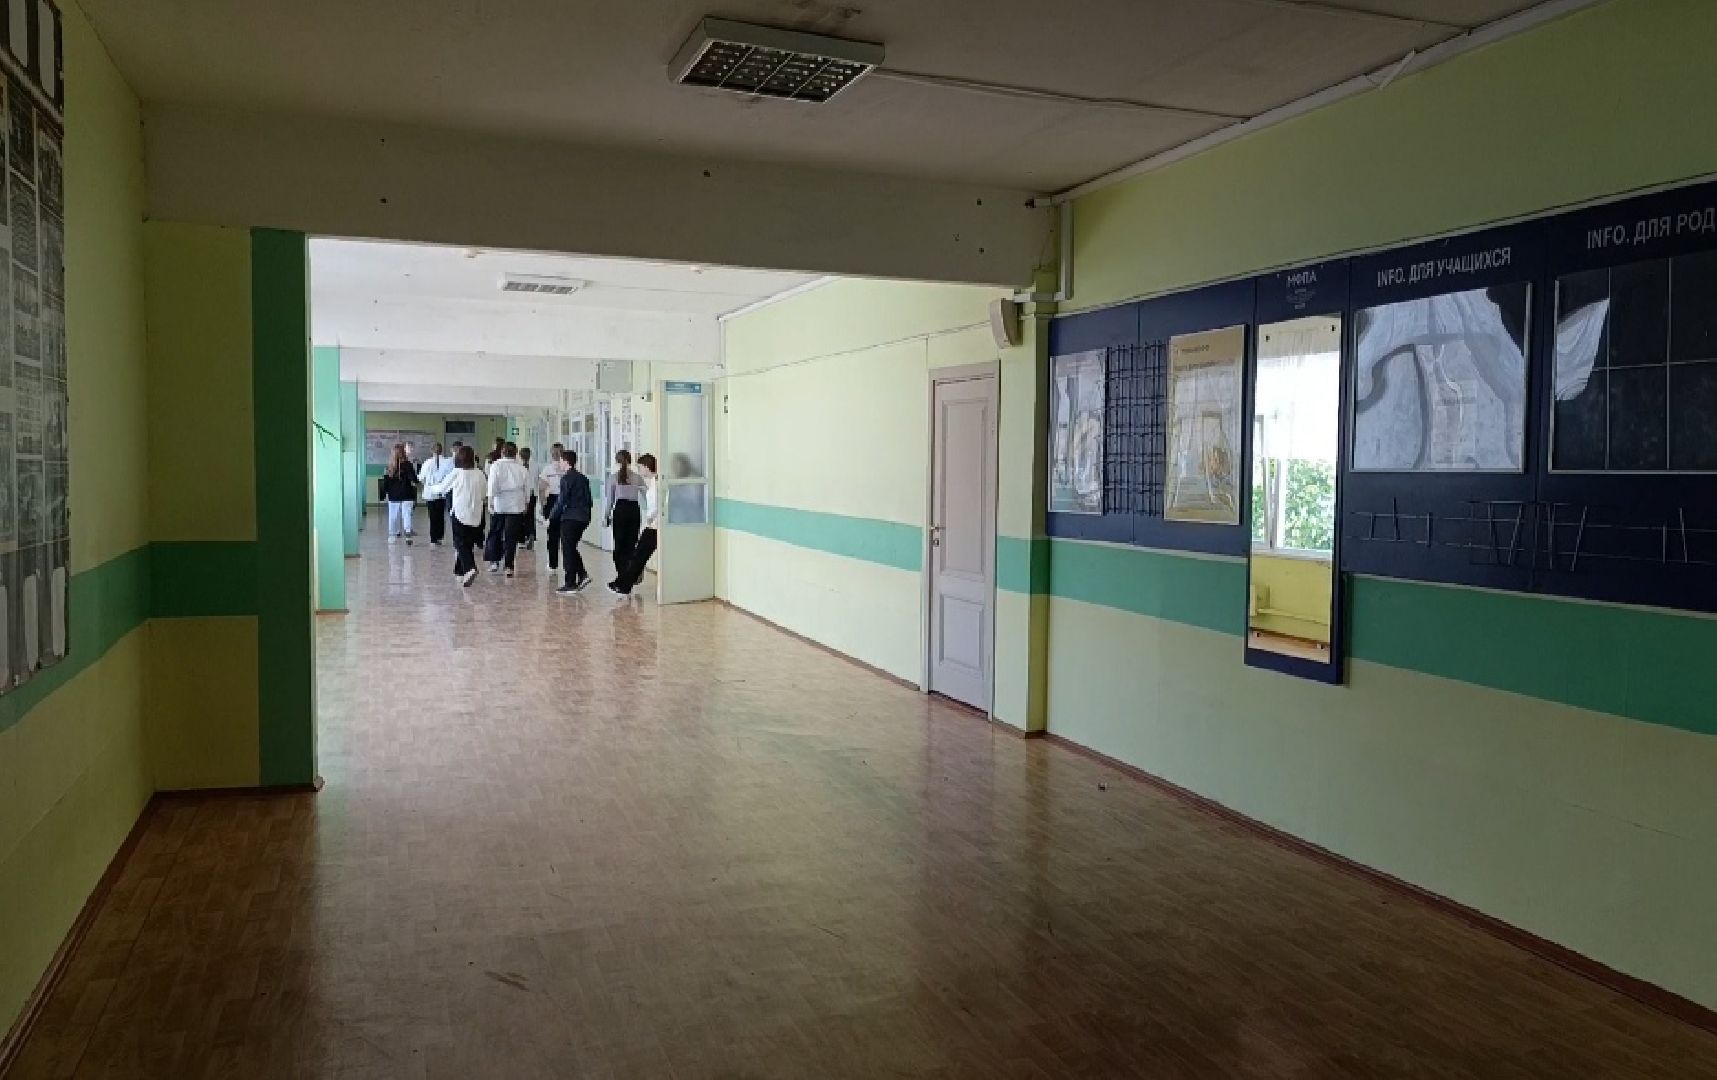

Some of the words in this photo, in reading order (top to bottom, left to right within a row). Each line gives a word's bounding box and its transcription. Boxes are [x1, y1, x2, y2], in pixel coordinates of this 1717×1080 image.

[1587, 224, 1630, 249] INFO.
[1633, 215, 1671, 246] ДЛЯ
[1675, 207, 1716, 236] РОД
[1377, 266, 1406, 288] INFO.
[1409, 260, 1434, 285] ДЛЯ
[1437, 246, 1511, 277] УЧАЩИХСЯ
